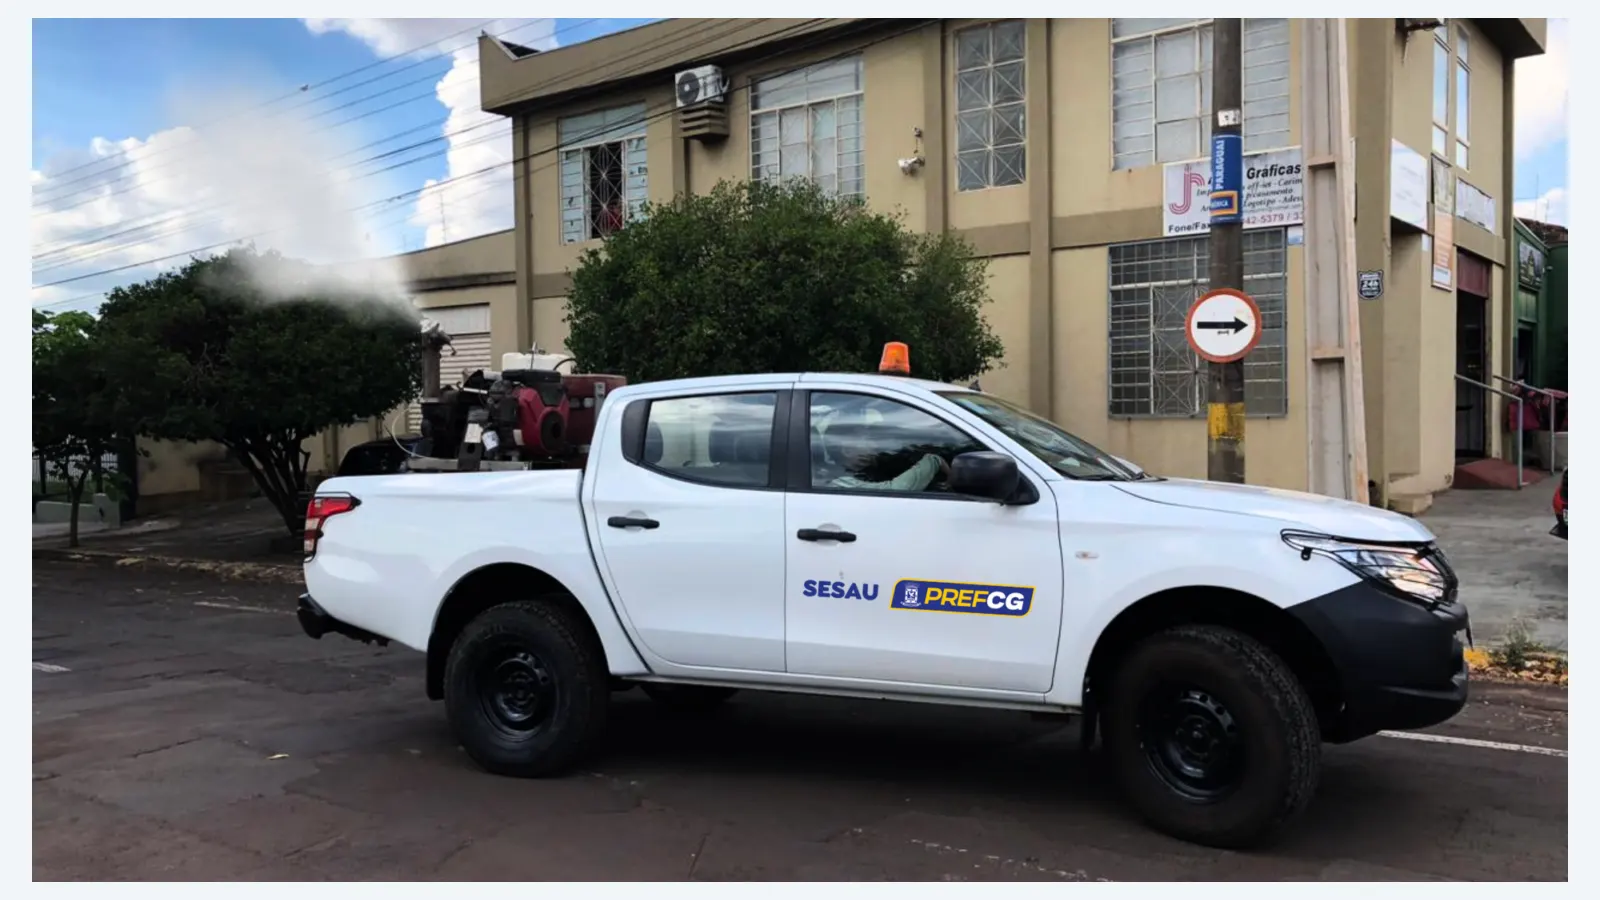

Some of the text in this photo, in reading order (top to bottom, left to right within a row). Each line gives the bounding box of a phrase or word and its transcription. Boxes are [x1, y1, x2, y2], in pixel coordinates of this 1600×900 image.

[1215, 139, 1225, 190] PARAGUAI
[1246, 163, 1302, 180] Gráficas
[802, 579, 1025, 611] SESAU PREFCG
